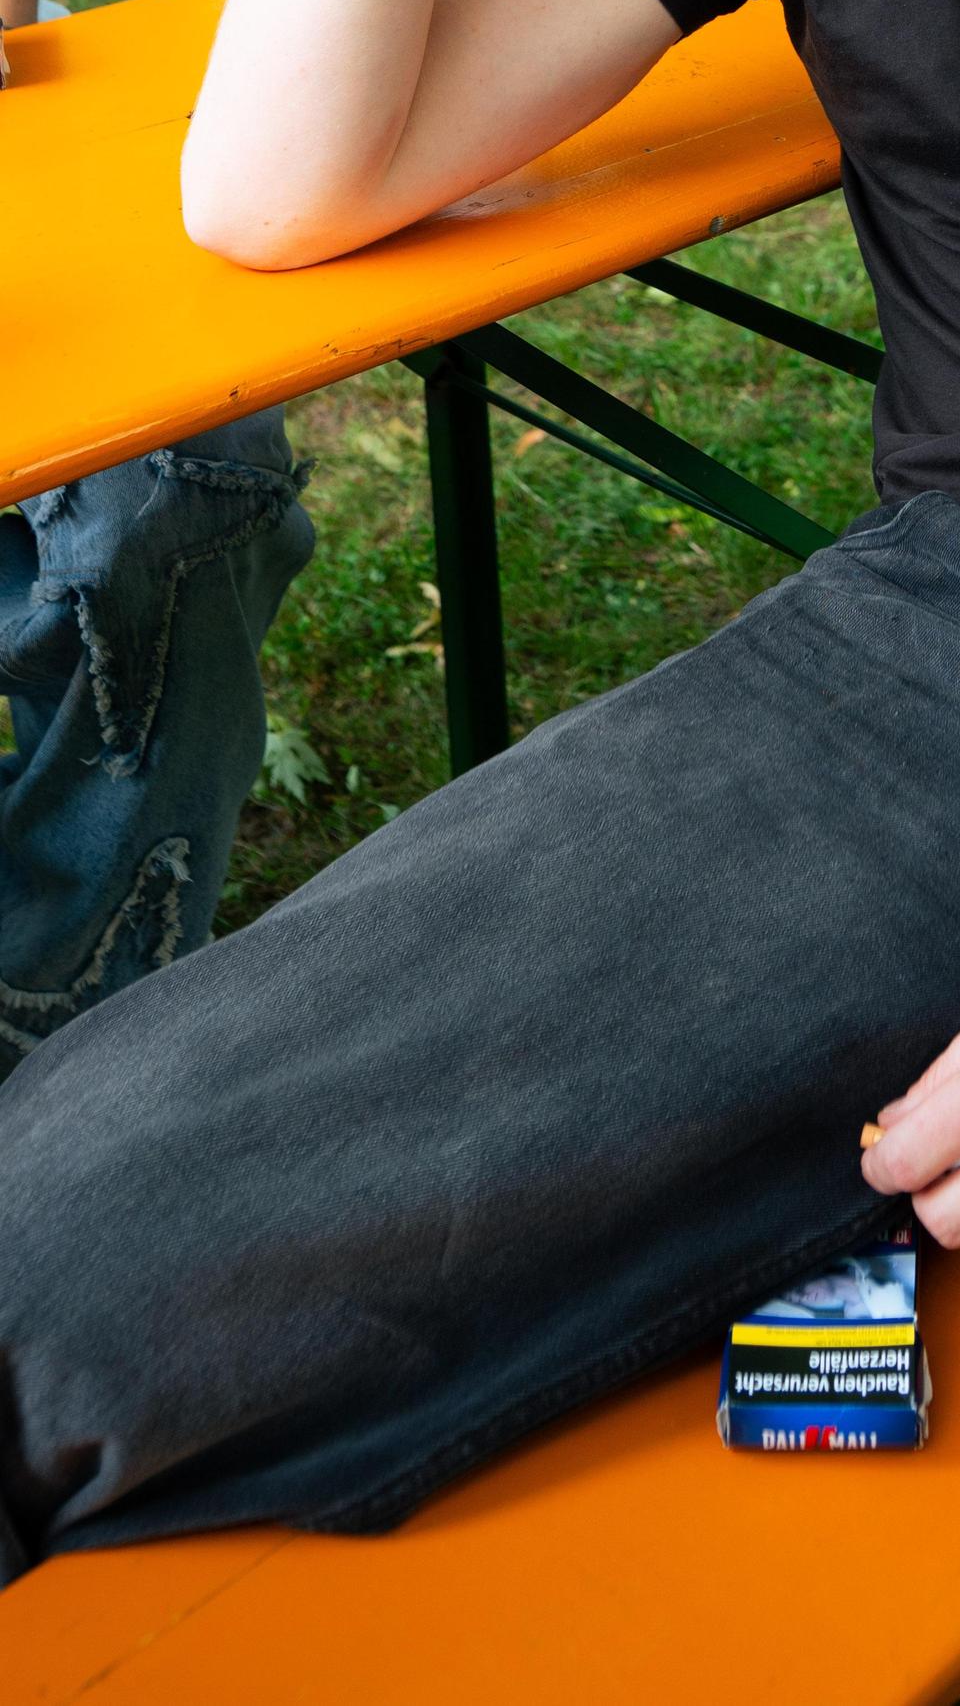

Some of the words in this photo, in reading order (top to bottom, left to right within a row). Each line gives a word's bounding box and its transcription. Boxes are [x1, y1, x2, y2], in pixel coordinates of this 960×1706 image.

[809, 1349, 910, 1374] Herzanfälle
[735, 1371, 829, 1396] verursacht
[834, 1372, 910, 1397] Rauchen
